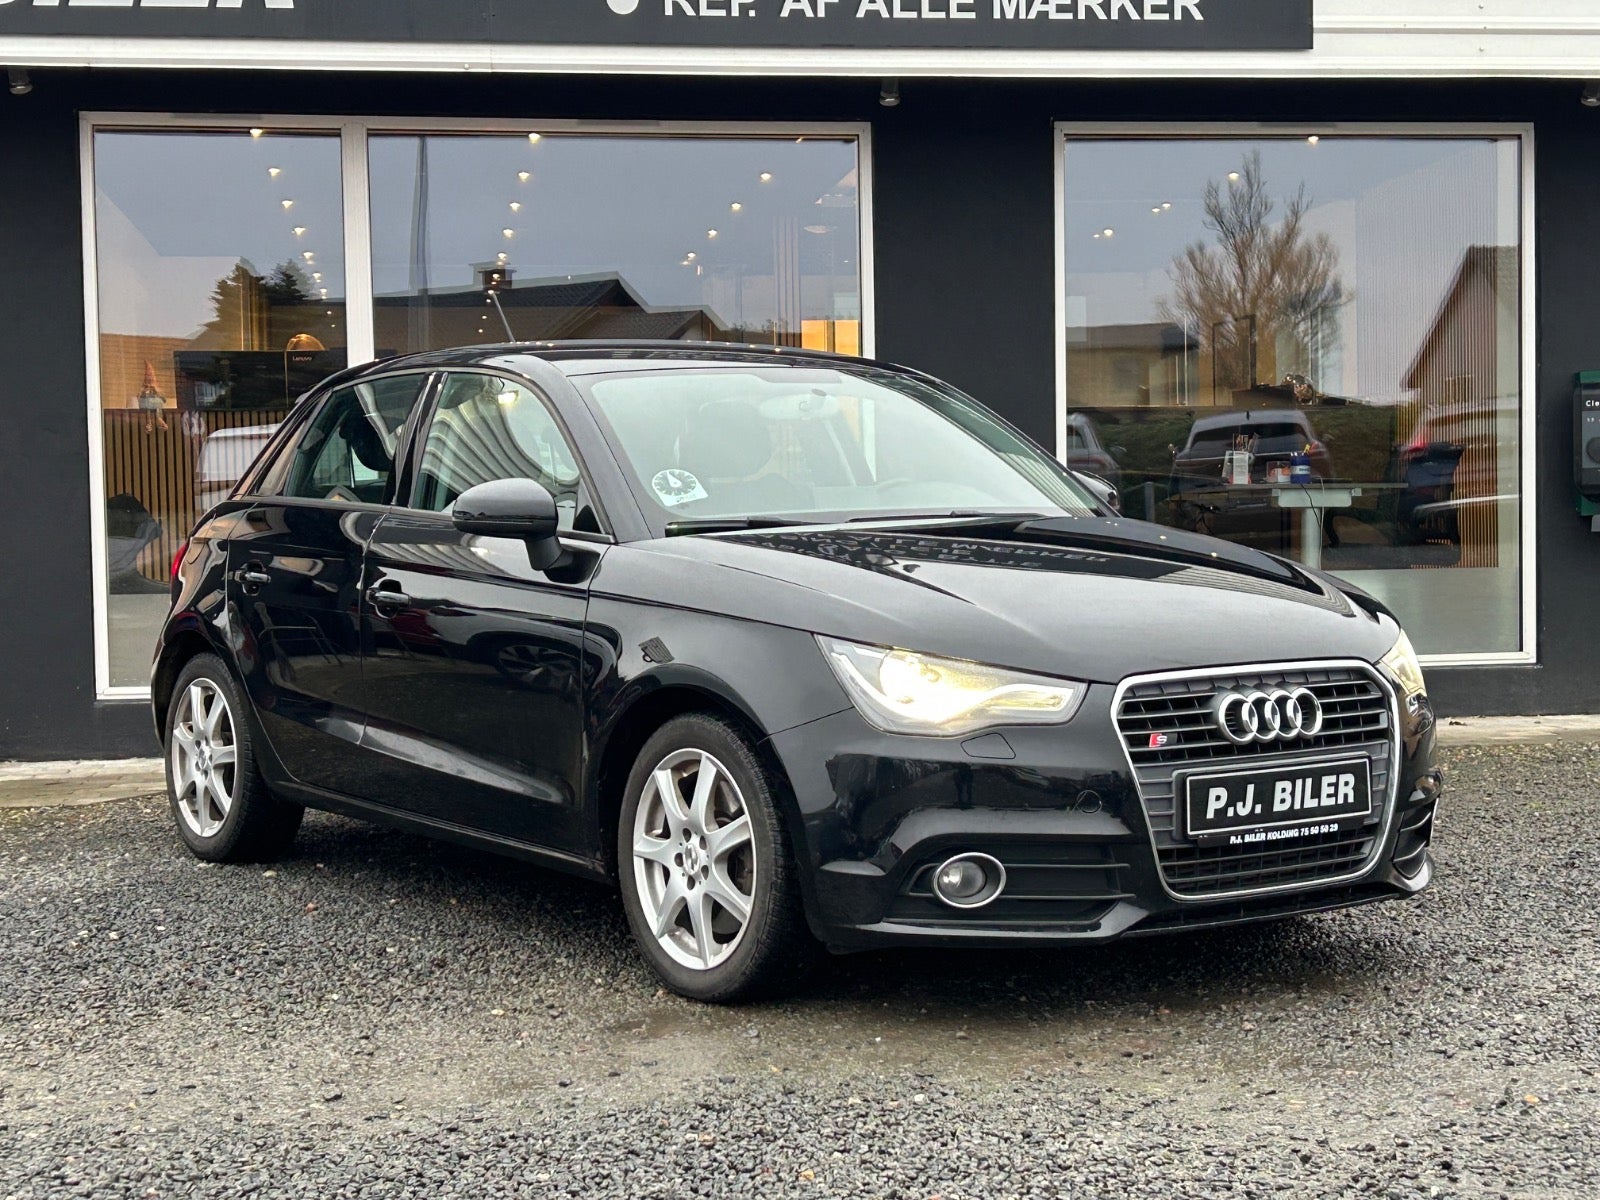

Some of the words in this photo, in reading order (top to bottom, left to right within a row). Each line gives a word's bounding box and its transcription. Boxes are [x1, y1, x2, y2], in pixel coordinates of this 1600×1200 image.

[1206, 783, 1262, 820] P.J.
[1272, 773, 1356, 813] BILER
[1244, 832, 1266, 843] BILER
[1267, 829, 1299, 840] KOLDING
[1300, 827, 1309, 836] 75
